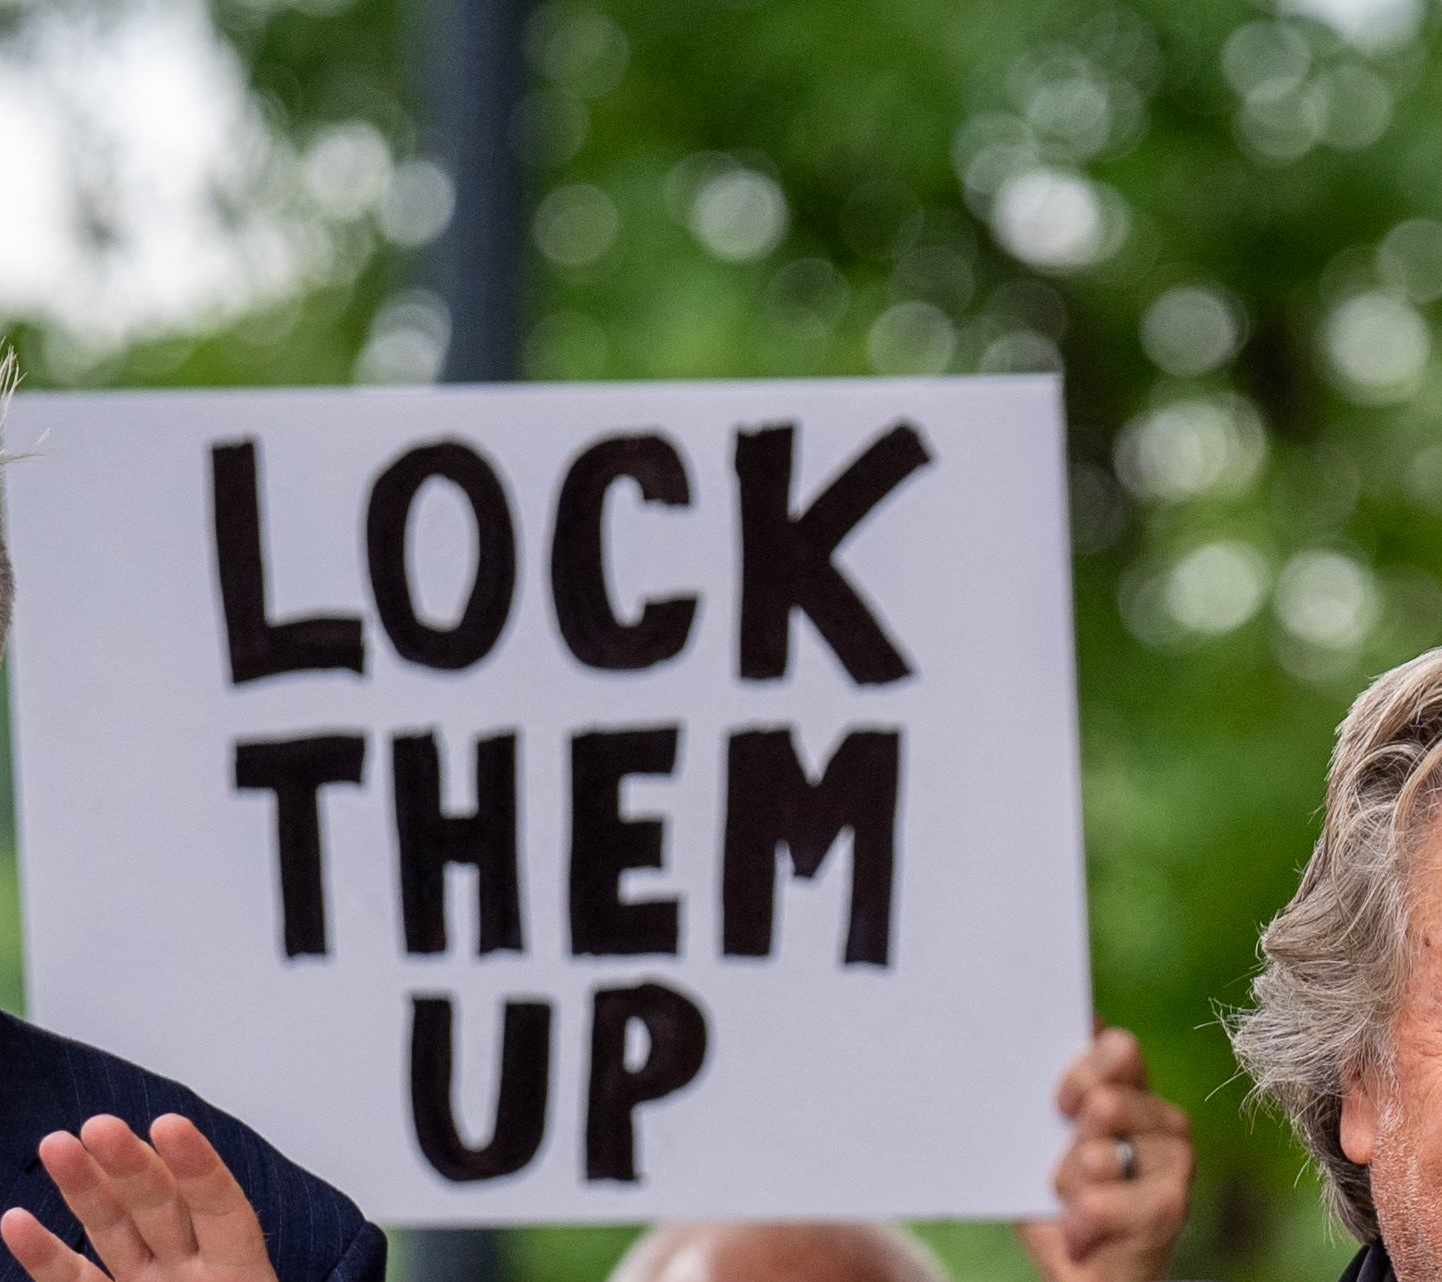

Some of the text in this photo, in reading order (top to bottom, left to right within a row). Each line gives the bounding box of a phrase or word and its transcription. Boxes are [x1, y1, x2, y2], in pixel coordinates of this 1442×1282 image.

[208, 421, 934, 687] LOCK
[232, 721, 903, 969] THEM
[408, 977, 711, 1185] UP
